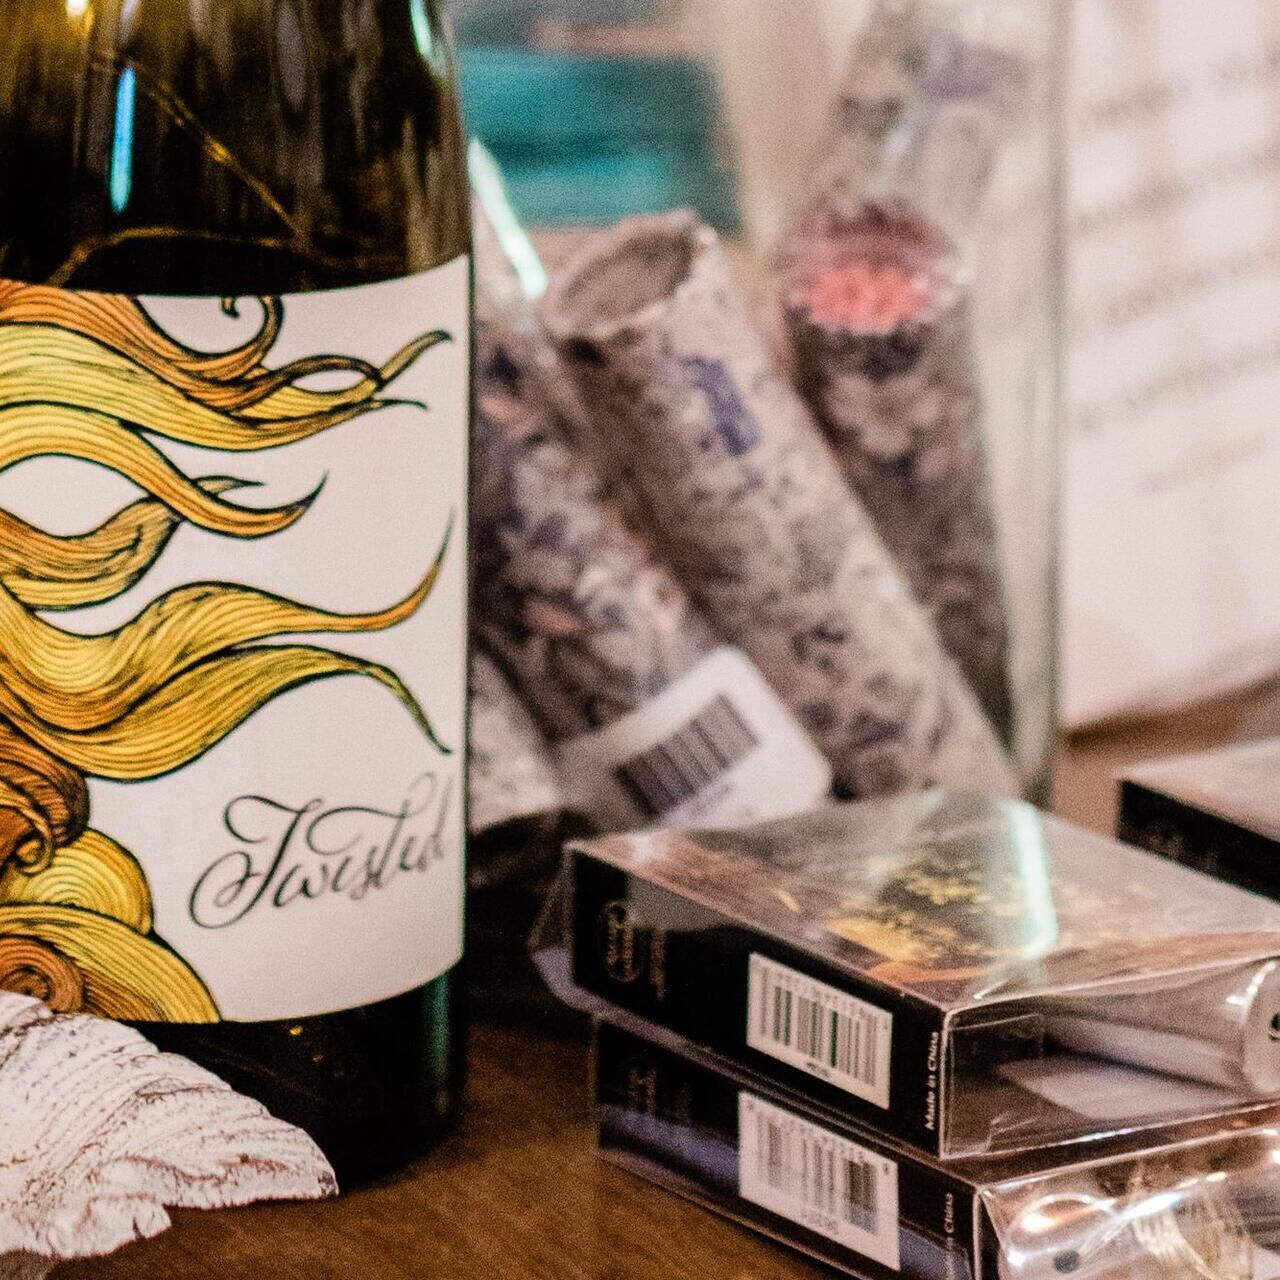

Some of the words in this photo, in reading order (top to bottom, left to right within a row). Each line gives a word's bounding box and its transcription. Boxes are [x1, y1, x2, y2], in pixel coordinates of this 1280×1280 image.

[188, 771, 454, 930] Twisted
[927, 1031, 939, 1072] China
[926, 1074, 937, 1089] in
[925, 1090, 936, 1131] Made
